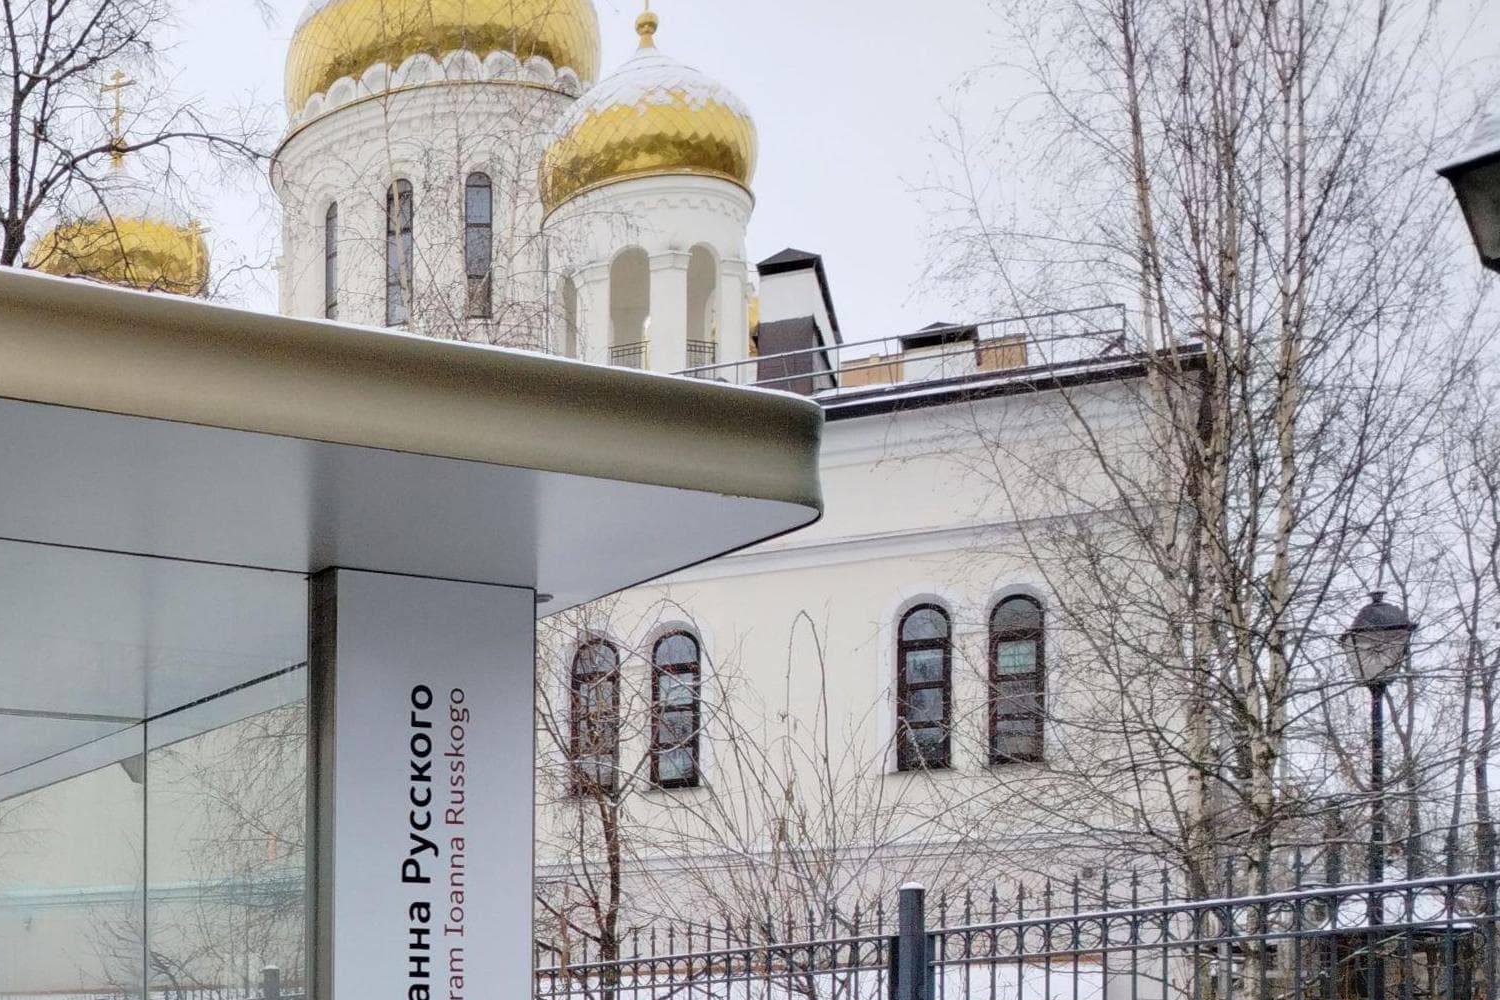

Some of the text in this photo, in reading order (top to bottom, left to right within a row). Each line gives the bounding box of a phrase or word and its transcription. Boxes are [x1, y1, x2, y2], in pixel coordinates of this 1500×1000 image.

[400, 684, 440, 885] Русского
[443, 687, 471, 826] Russkogo
[443, 836, 466, 938] Ioanna
